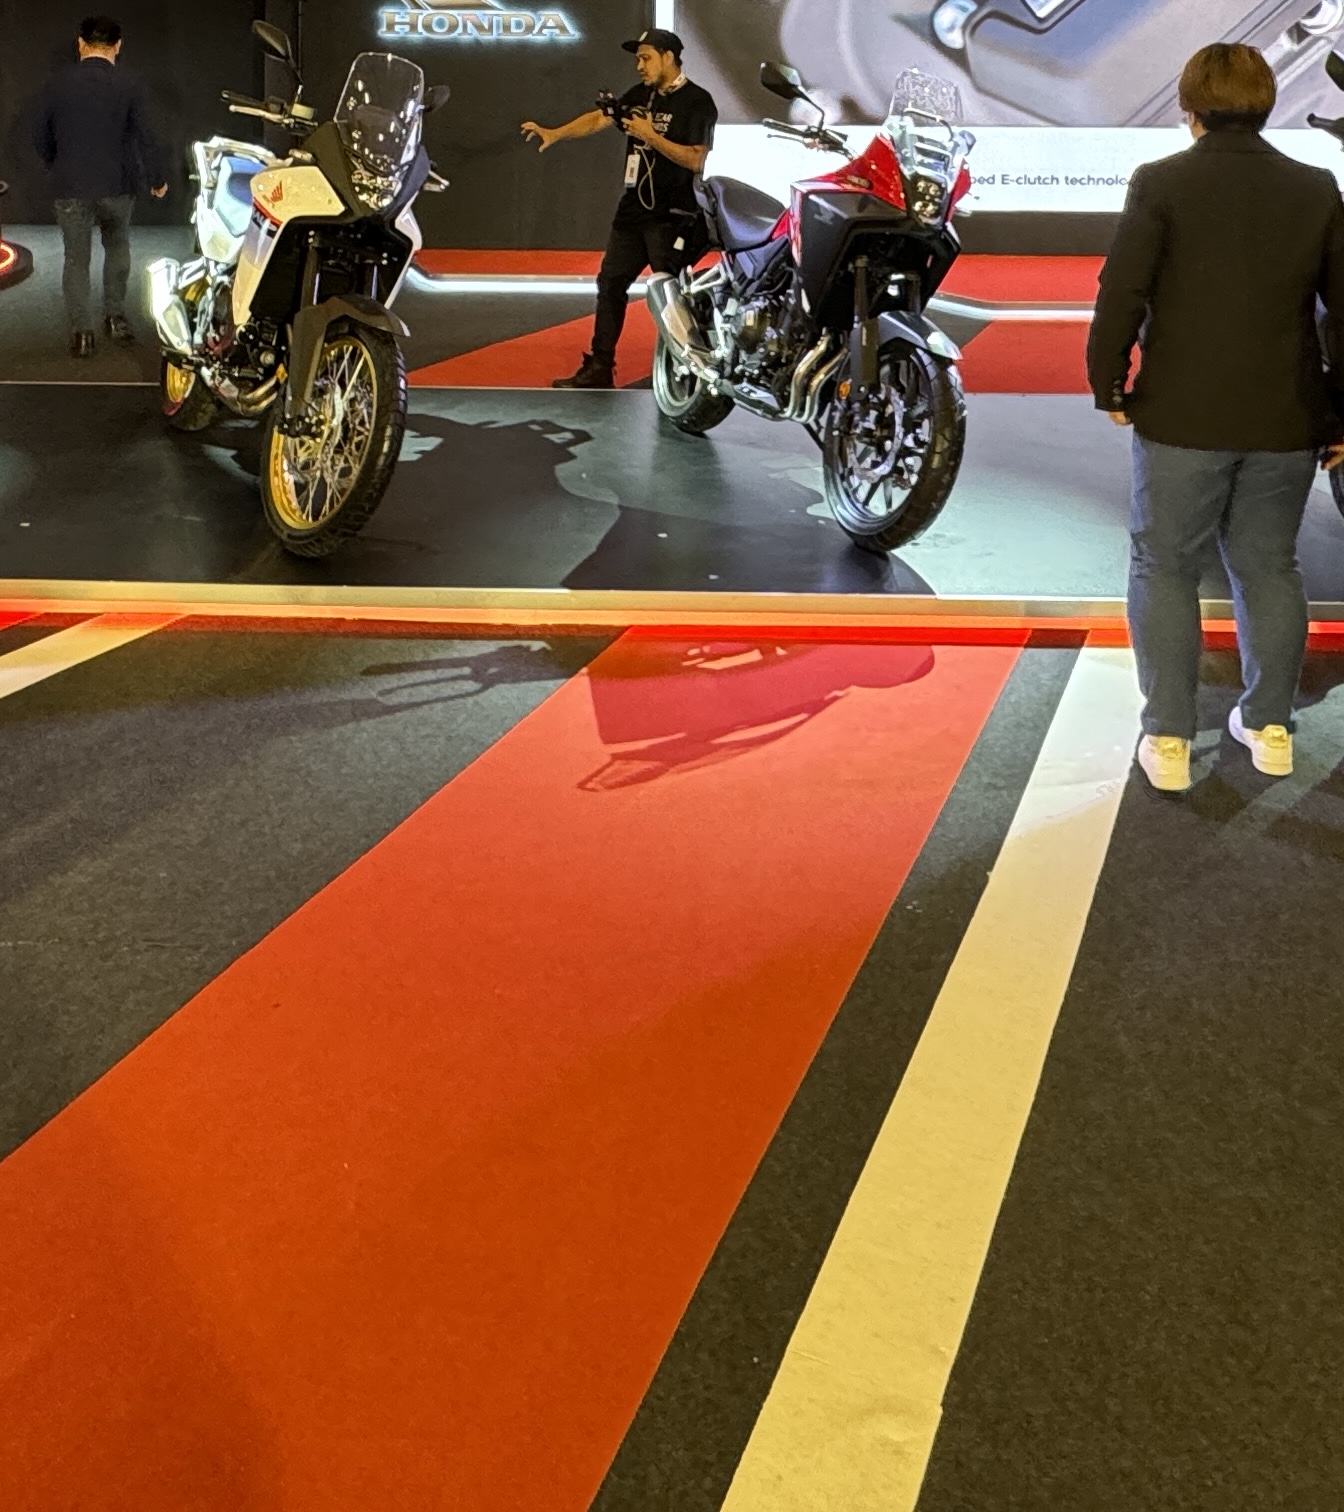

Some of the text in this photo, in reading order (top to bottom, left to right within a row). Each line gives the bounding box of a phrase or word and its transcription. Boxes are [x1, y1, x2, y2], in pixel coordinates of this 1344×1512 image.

[380, 10, 577, 37] HONDA
[1001, 174, 1060, 186] E-clutch
[1064, 174, 1129, 187] technolo
